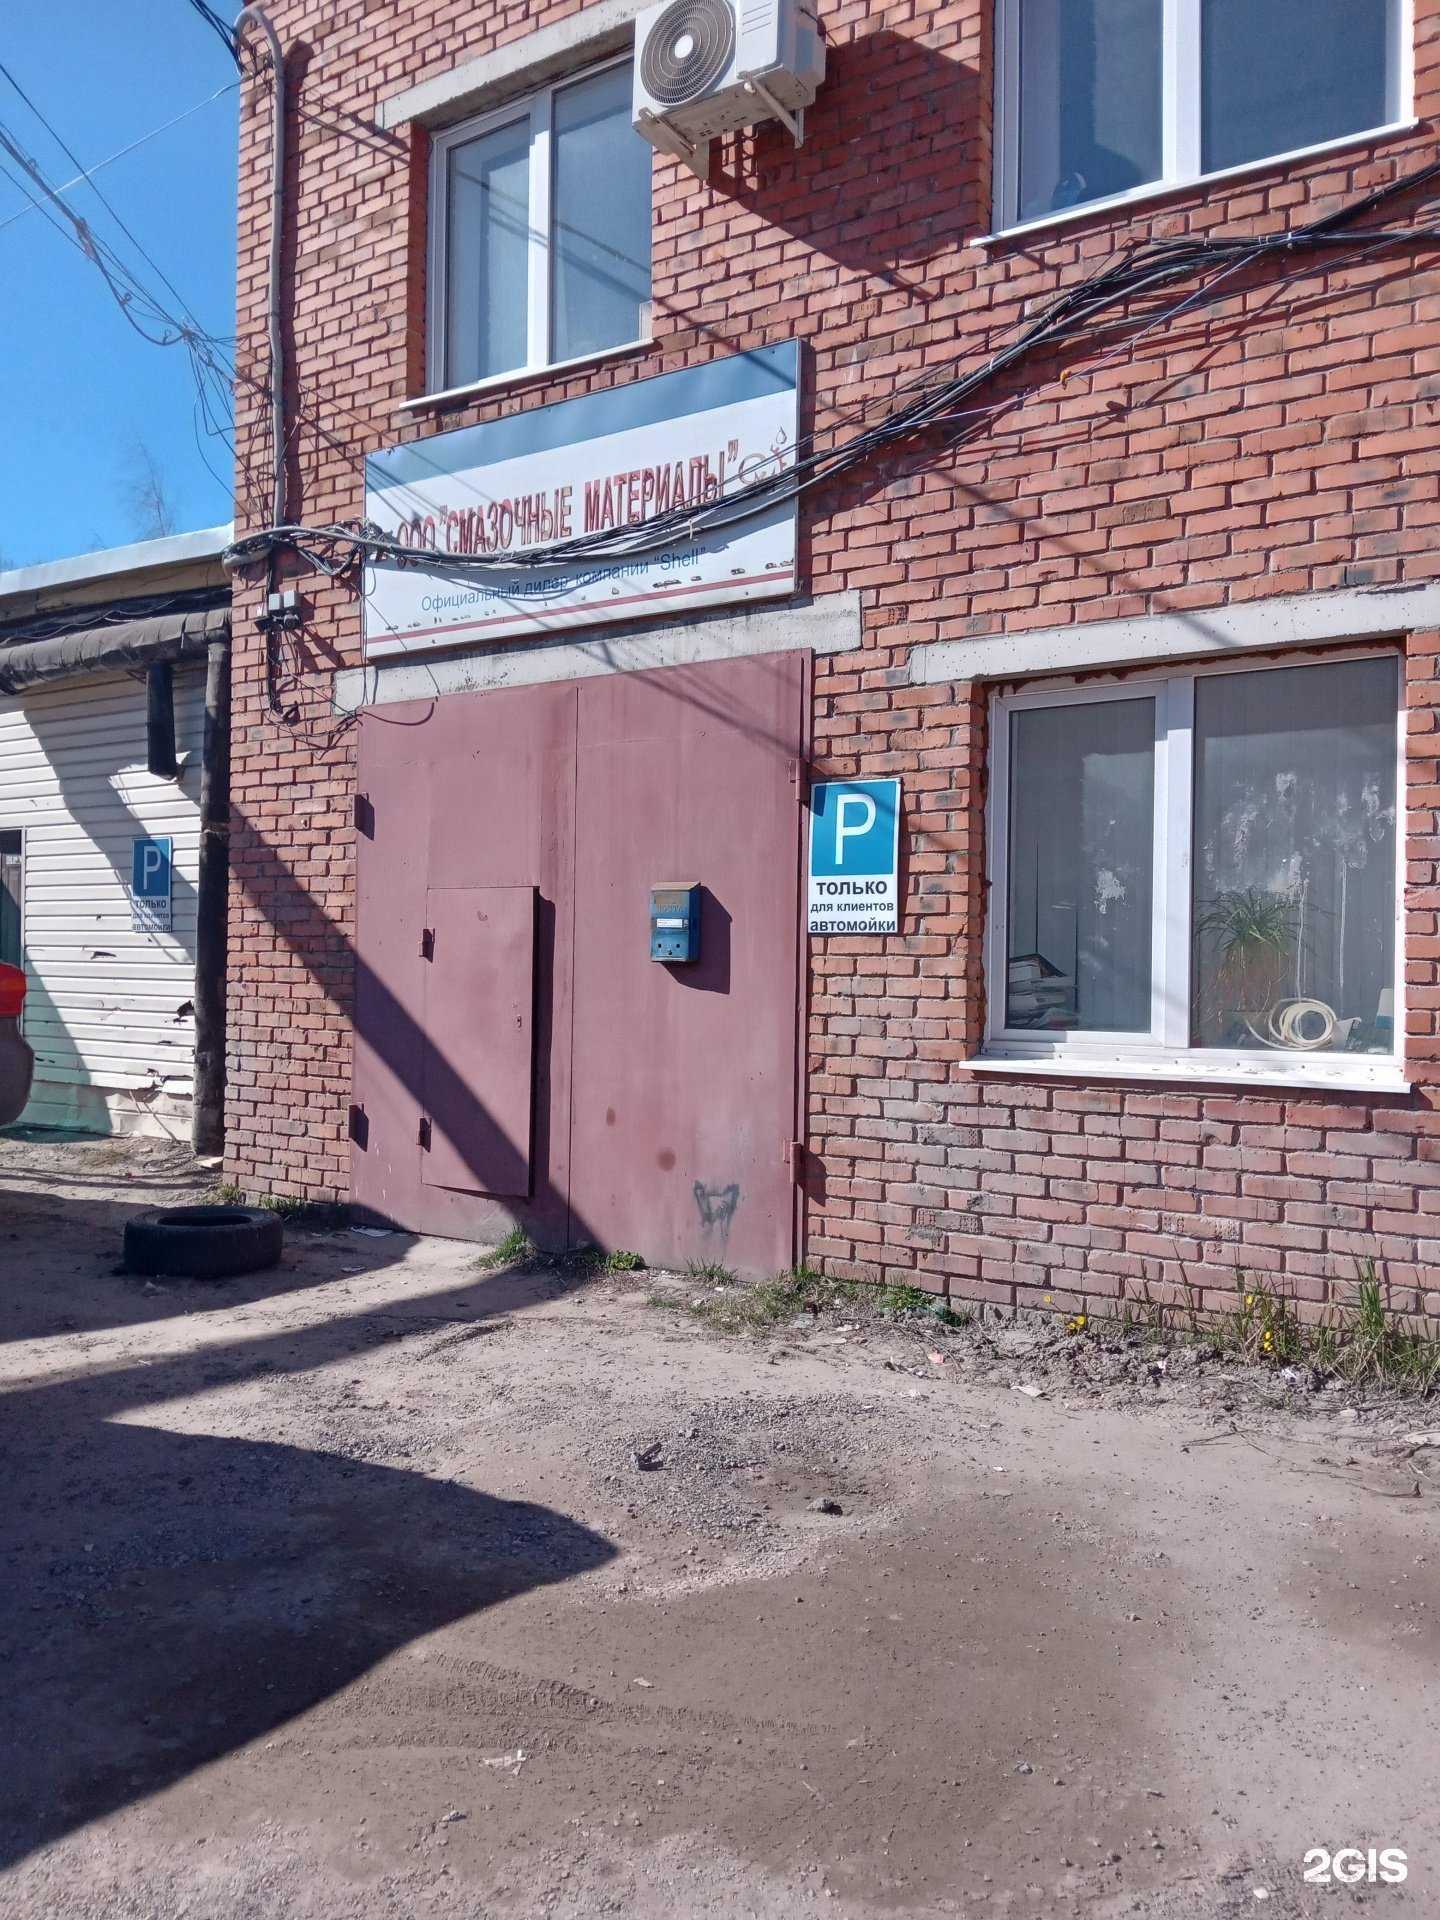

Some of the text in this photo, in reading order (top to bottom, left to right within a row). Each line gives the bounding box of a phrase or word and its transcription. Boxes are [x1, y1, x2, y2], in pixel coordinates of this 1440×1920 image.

[421, 579, 520, 613] Официальный
[523, 575, 568, 597] дилер
[575, 560, 649, 584] компании
[810, 902, 894, 913] для клиентов
[810, 916, 896, 932] автомойки
